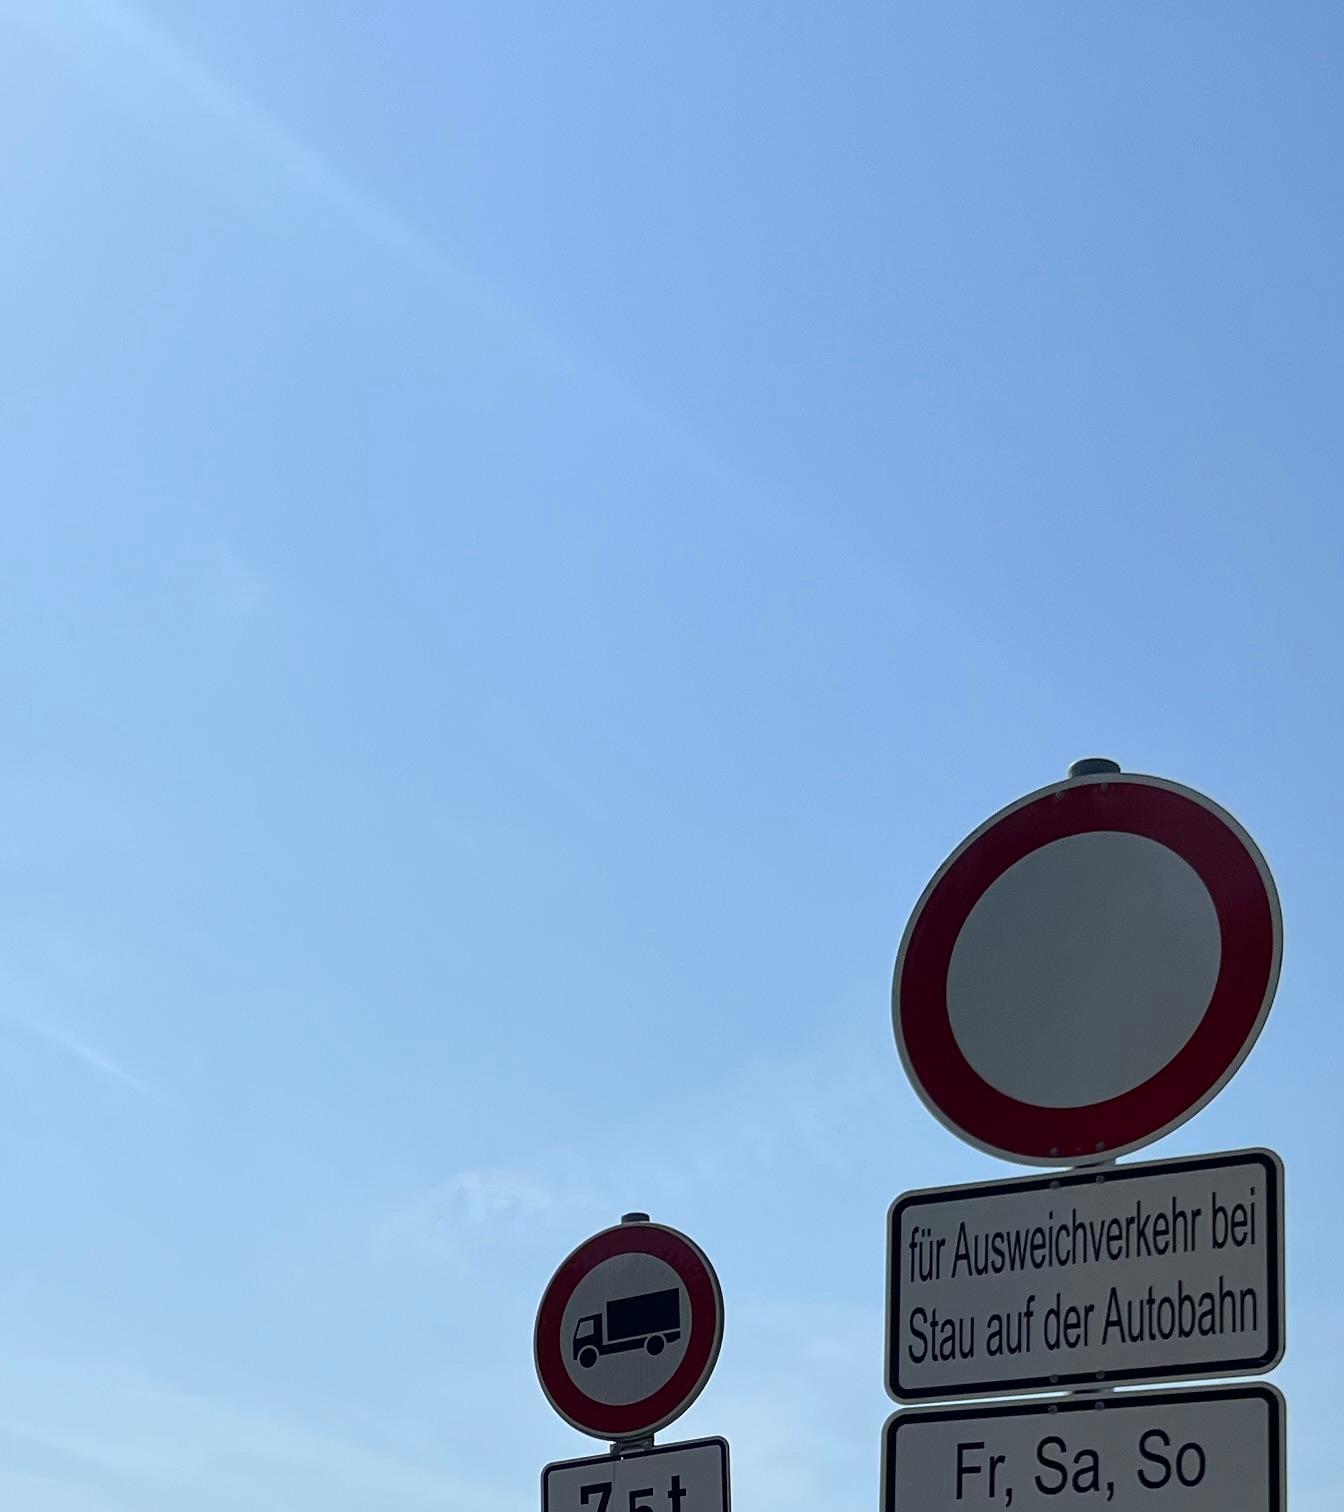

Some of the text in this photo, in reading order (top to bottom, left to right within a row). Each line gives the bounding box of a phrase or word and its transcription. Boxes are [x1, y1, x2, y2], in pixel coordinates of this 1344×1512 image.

[908, 1187, 1256, 1283] für Ausweichverkehr bei
[908, 1275, 1258, 1364] Stau auf der Autobahn
[955, 1429, 1206, 1507] Fr, Sa, So
